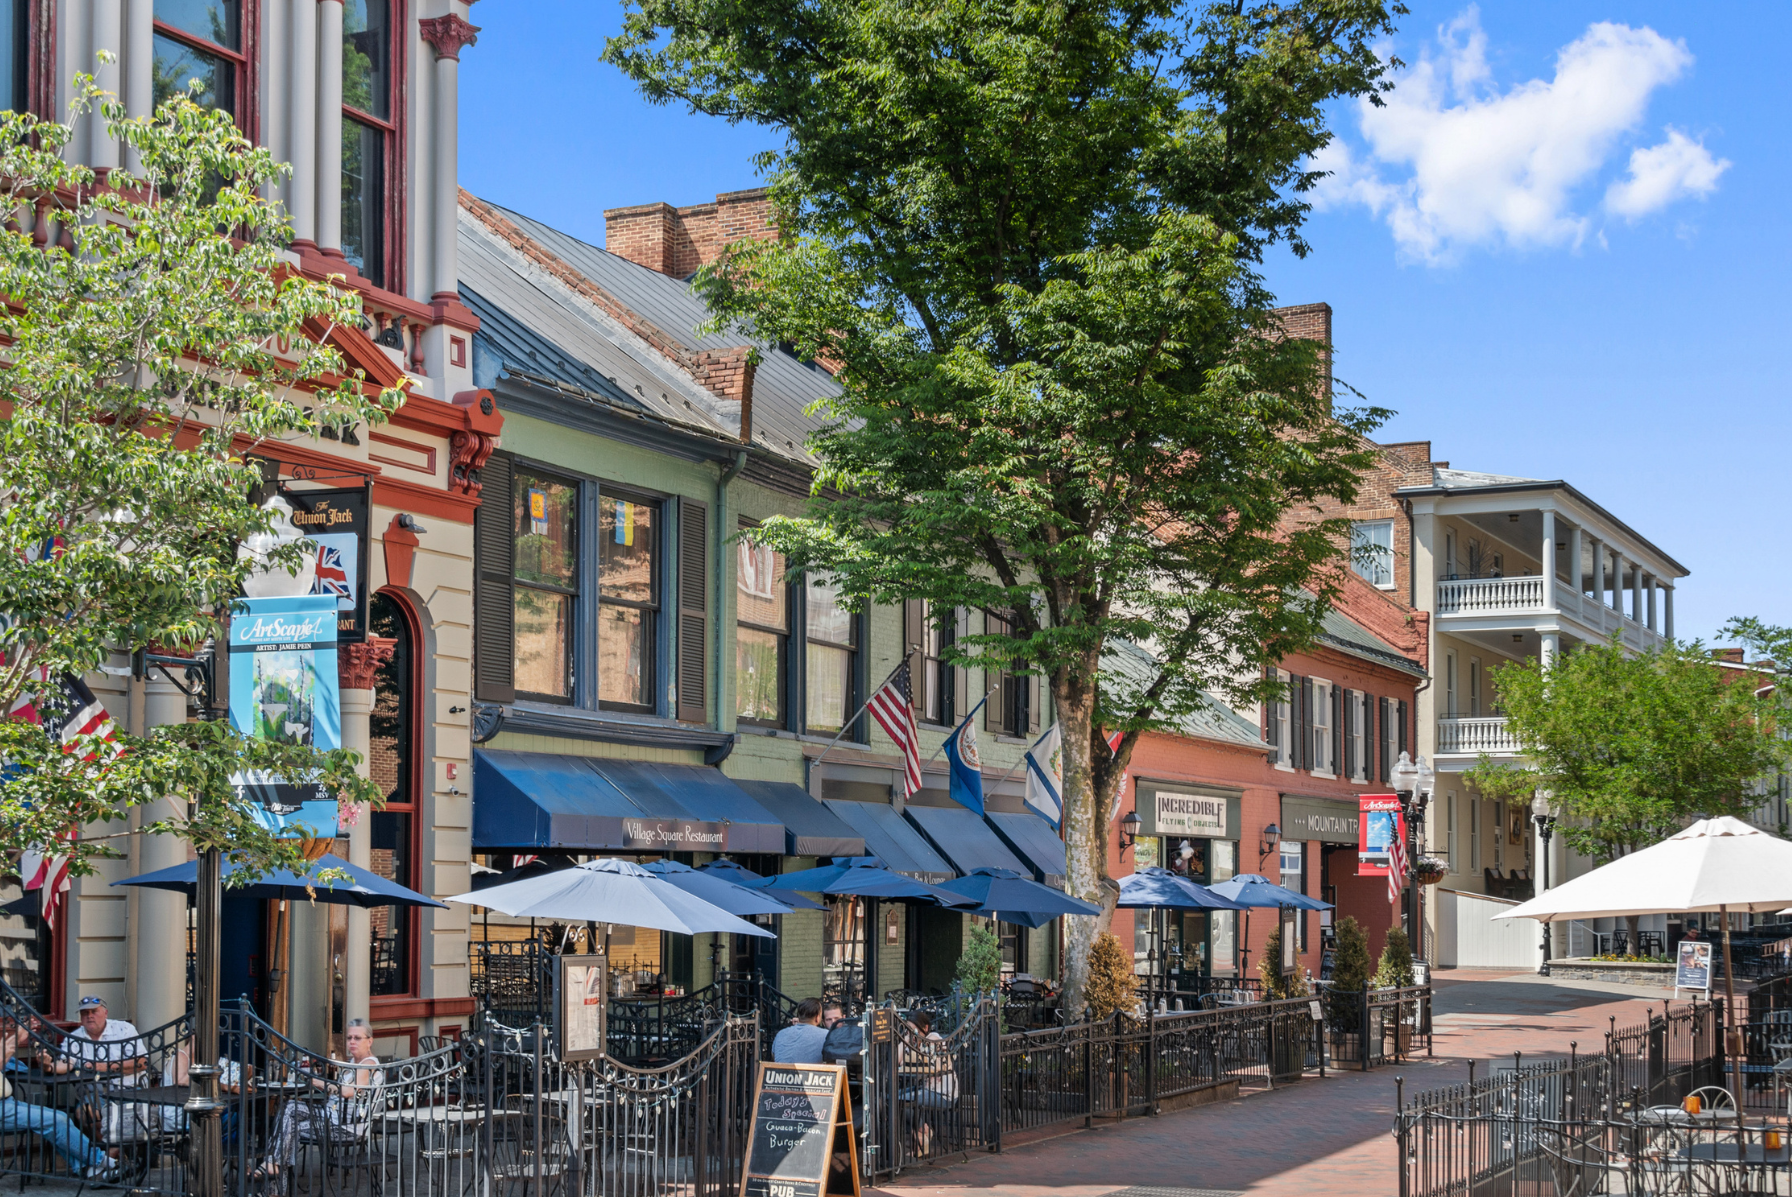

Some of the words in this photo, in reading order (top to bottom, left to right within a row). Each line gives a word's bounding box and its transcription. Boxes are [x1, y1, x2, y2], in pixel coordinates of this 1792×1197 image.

[315, 500, 330, 512] The
[293, 510, 327, 526] Union
[326, 508, 353, 526] Jack
[279, 643, 296, 651] JAMIE
[1158, 797, 1225, 828] INCREDIBLE
[1162, 818, 1186, 826] FLYING
[1194, 820, 1218, 828] OBJECTS
[1307, 815, 1347, 833] MOUNTAIN
[627, 822, 656, 845] Village
[657, 824, 684, 845] Square
[685, 825, 723, 843] Restaurant
[765, 1070, 803, 1085] UNION
[804, 1072, 833, 1086] JACK
[764, 1096, 810, 1110] Today's
[782, 1108, 827, 1120] Special
[765, 1121, 821, 1134] Guaca-Bacon
[770, 1134, 806, 1151] Burger
[769, 1185, 795, 1197] PUB
